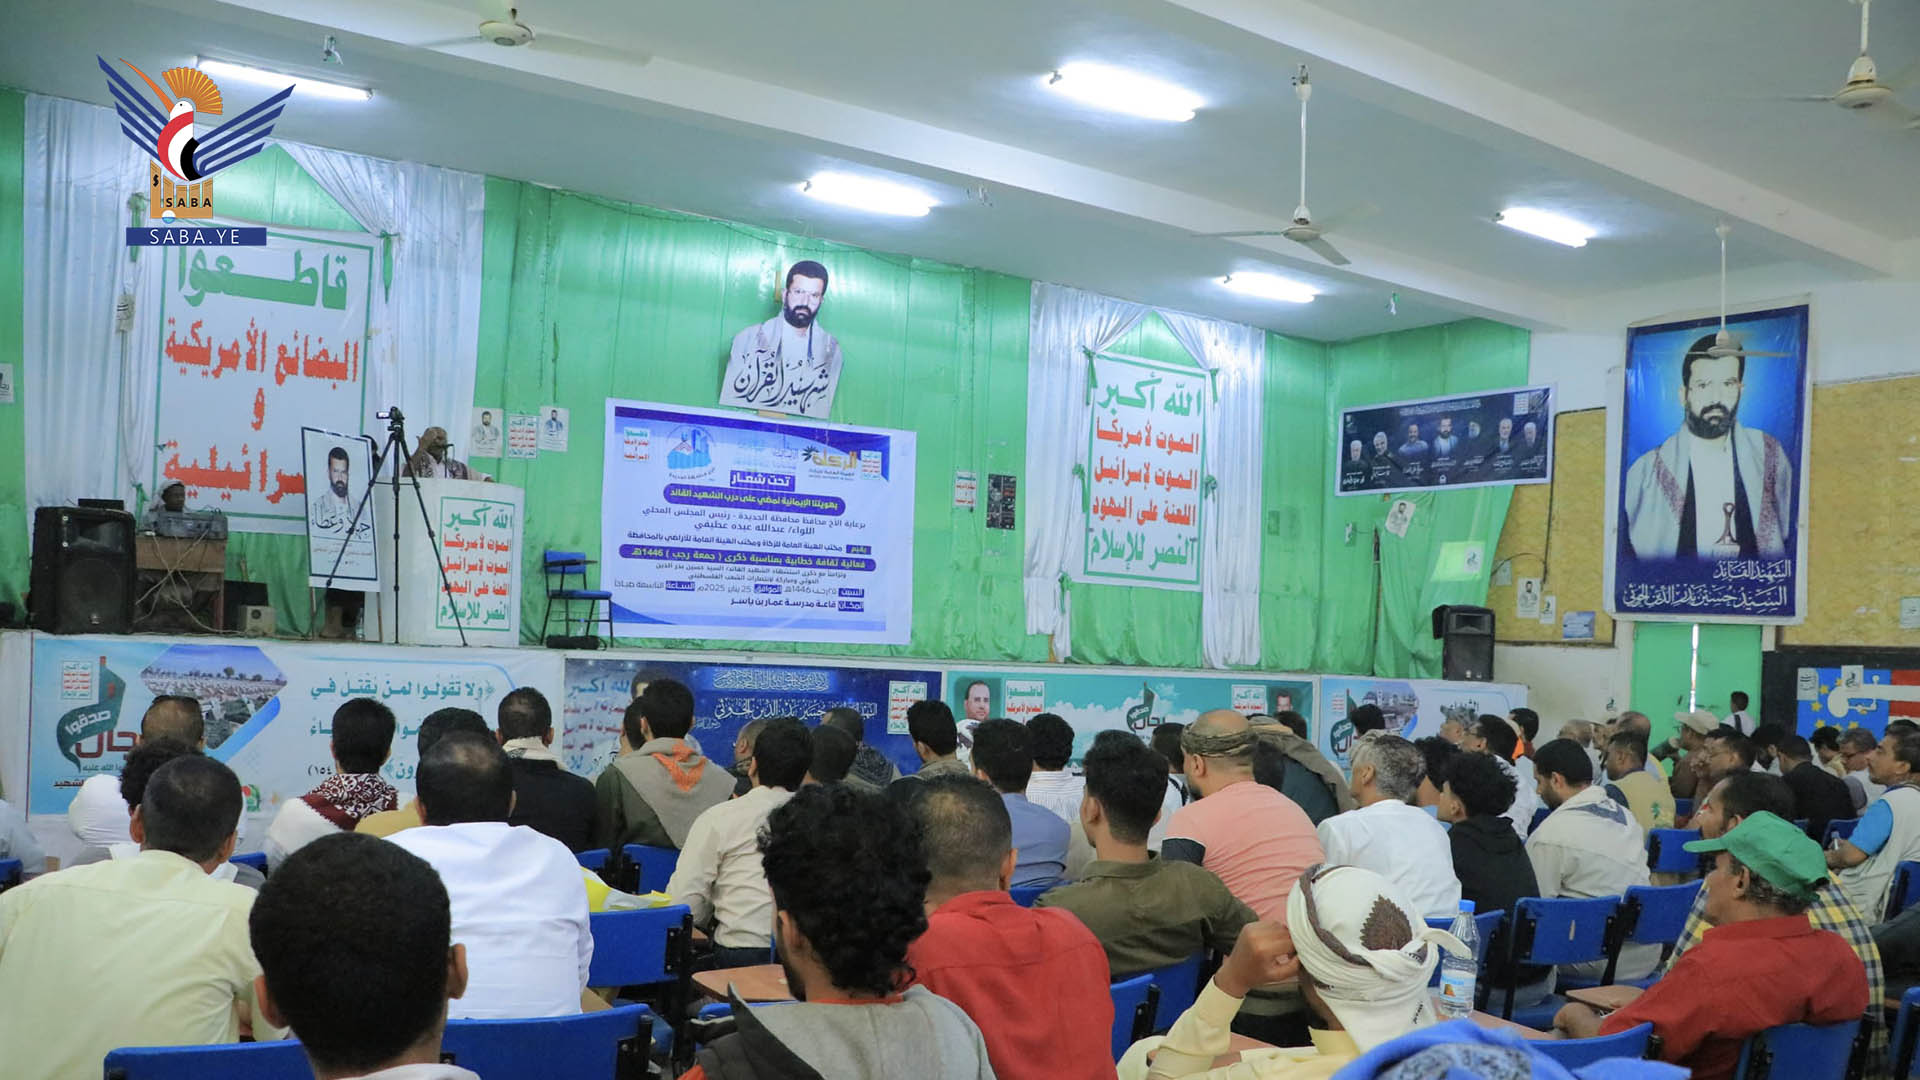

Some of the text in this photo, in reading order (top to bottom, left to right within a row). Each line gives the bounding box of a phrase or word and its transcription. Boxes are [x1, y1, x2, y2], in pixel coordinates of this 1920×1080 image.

[178, 246, 347, 310] قاطعوا
[165, 317, 359, 390] البضائع الأمريكية
[252, 387, 265, 431] و
[1096, 372, 1201, 416] الله أكبر
[1096, 416, 1199, 456] الموت لأمريكا
[731, 471, 766, 485] شعار
[768, 475, 791, 487] تحت
[1094, 455, 1198, 492] الموت لإسرائيل
[444, 503, 512, 532] الله أكبر
[1092, 495, 1196, 526] اللعنة على اليهود
[444, 533, 512, 553] الموت لأمريكا
[1090, 528, 1194, 571] النصر للإسلام
[486, 560, 510, 576] الموت
[474, 581, 489, 597] على
[483, 601, 509, 624] النصر
[65, 710, 112, 735] صدقوا
[75, 728, 138, 760] جال
